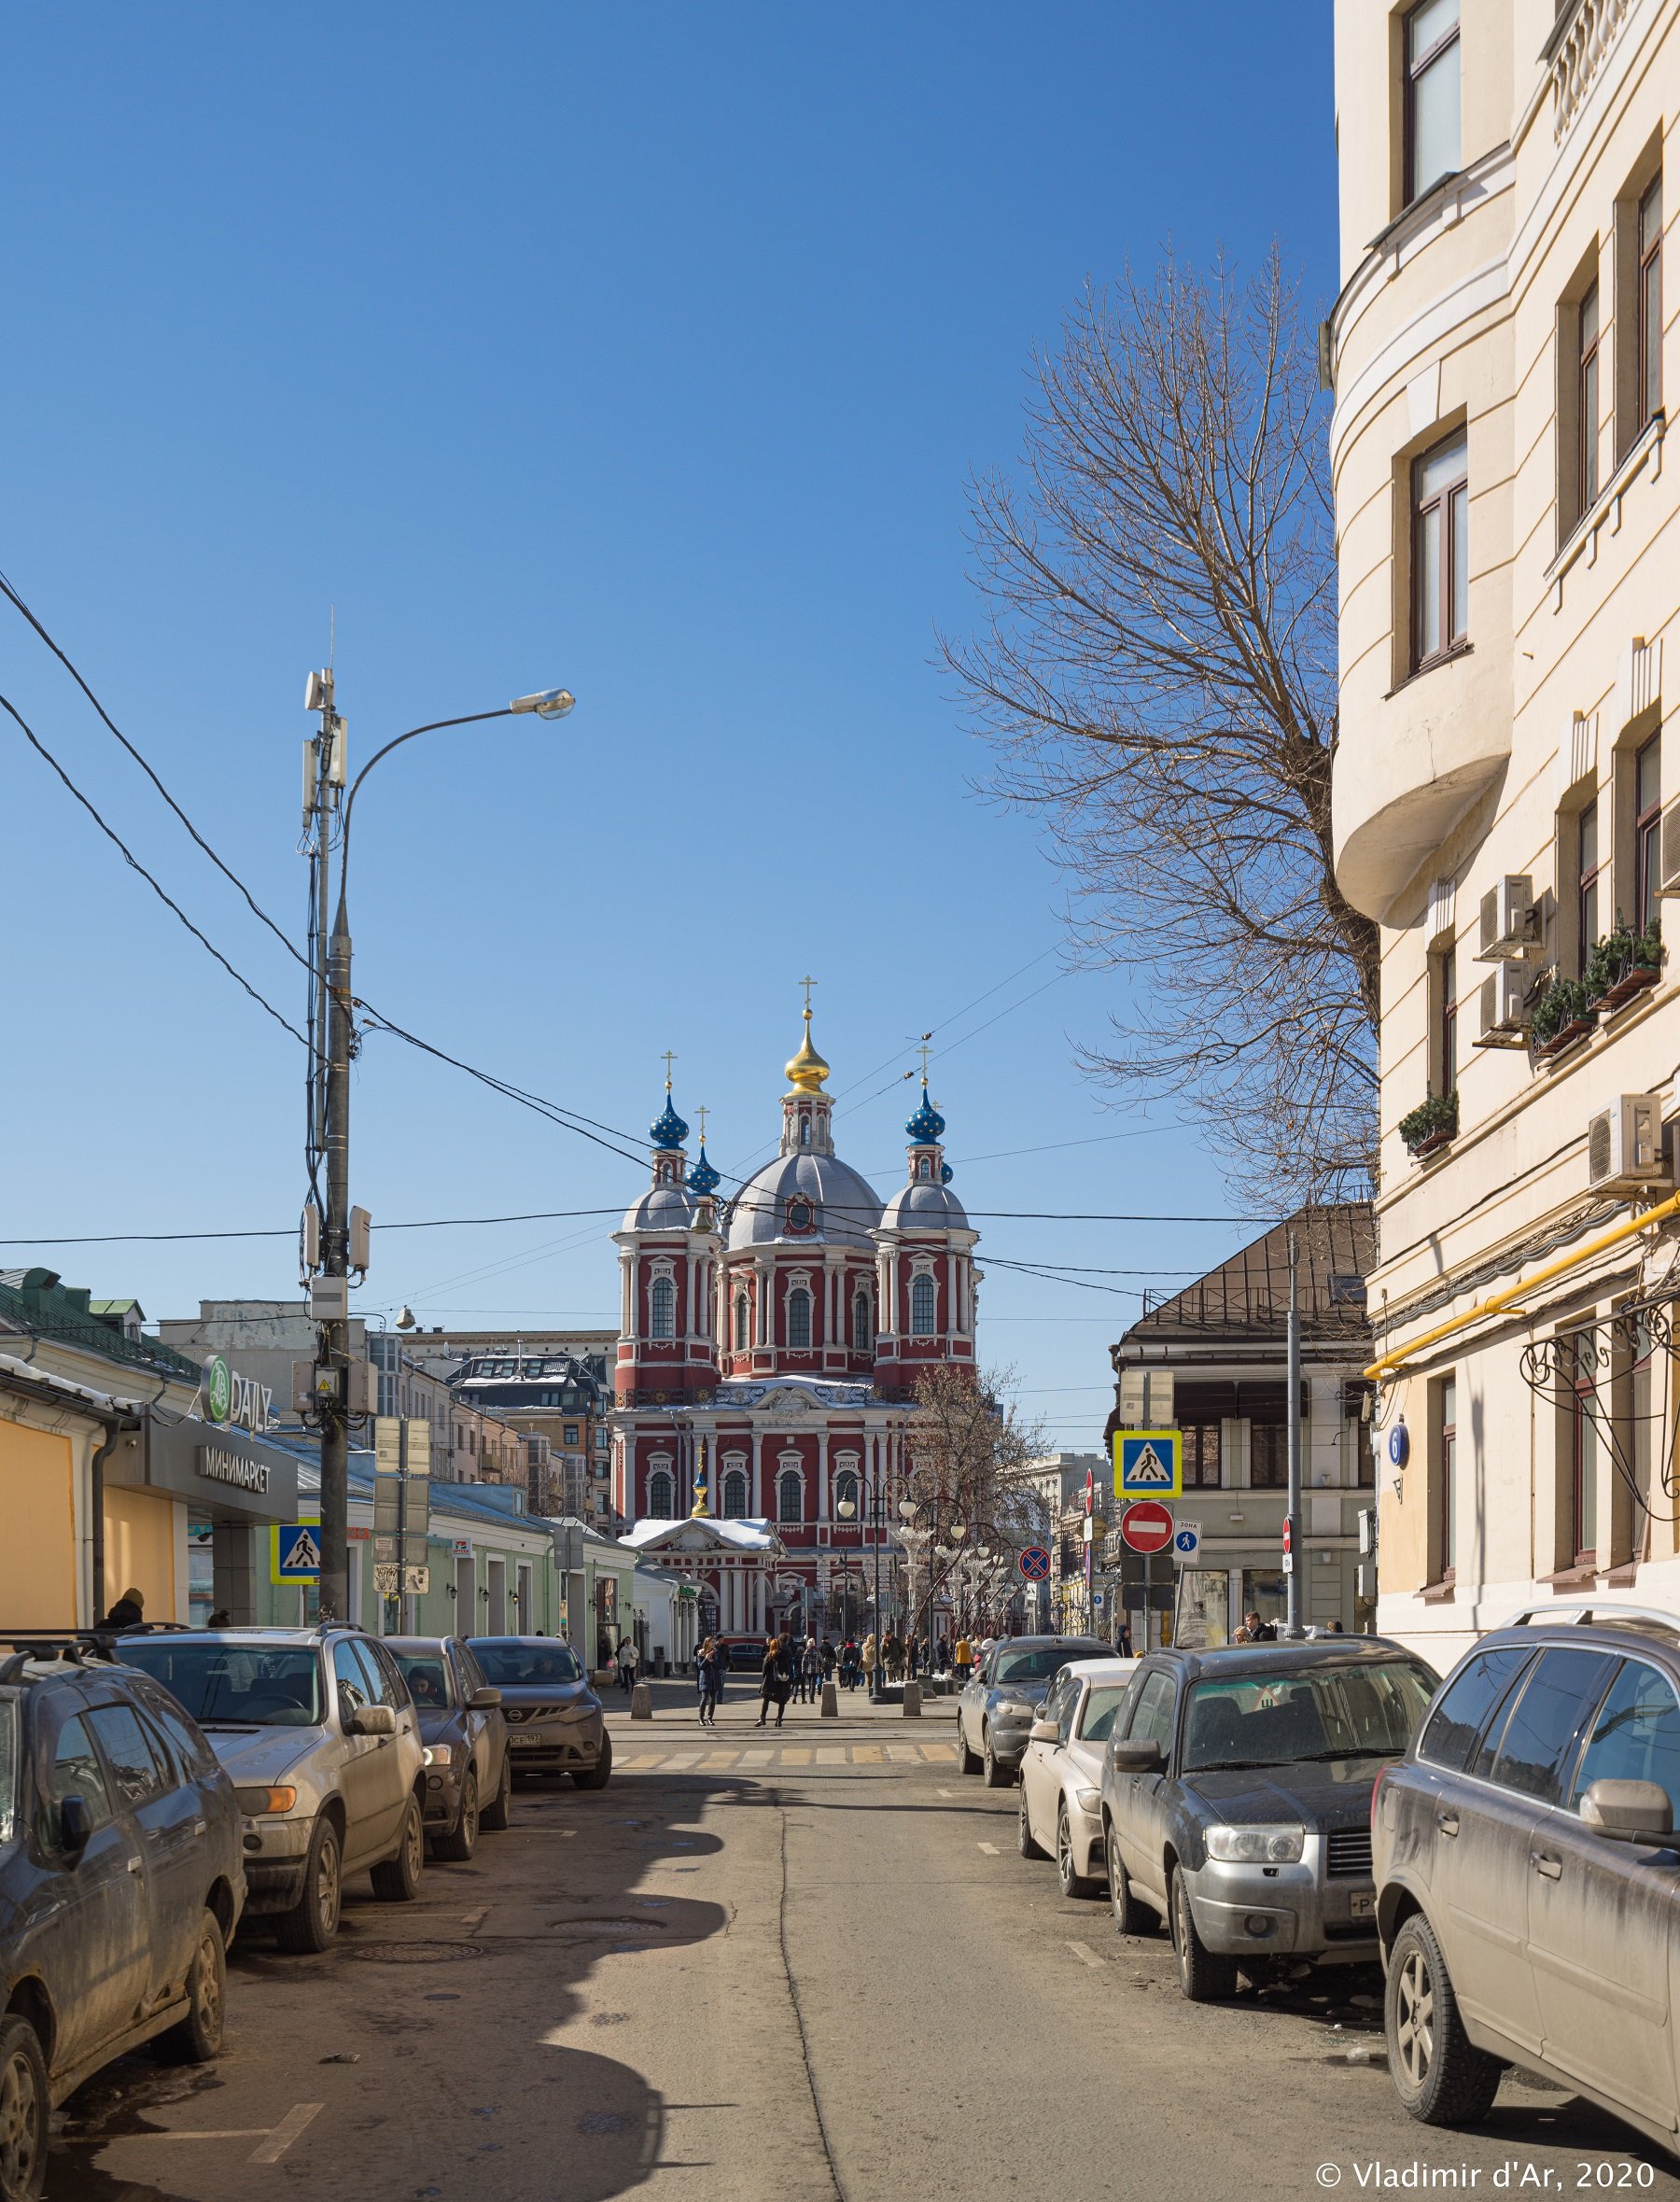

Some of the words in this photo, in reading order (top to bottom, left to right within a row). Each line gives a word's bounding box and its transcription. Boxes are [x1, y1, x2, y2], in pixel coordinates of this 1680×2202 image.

[231, 1370, 273, 1434] DAILY
[1392, 1432, 1398, 1459] 6
[206, 1446, 271, 1494] МИНИМАРКЕТ
